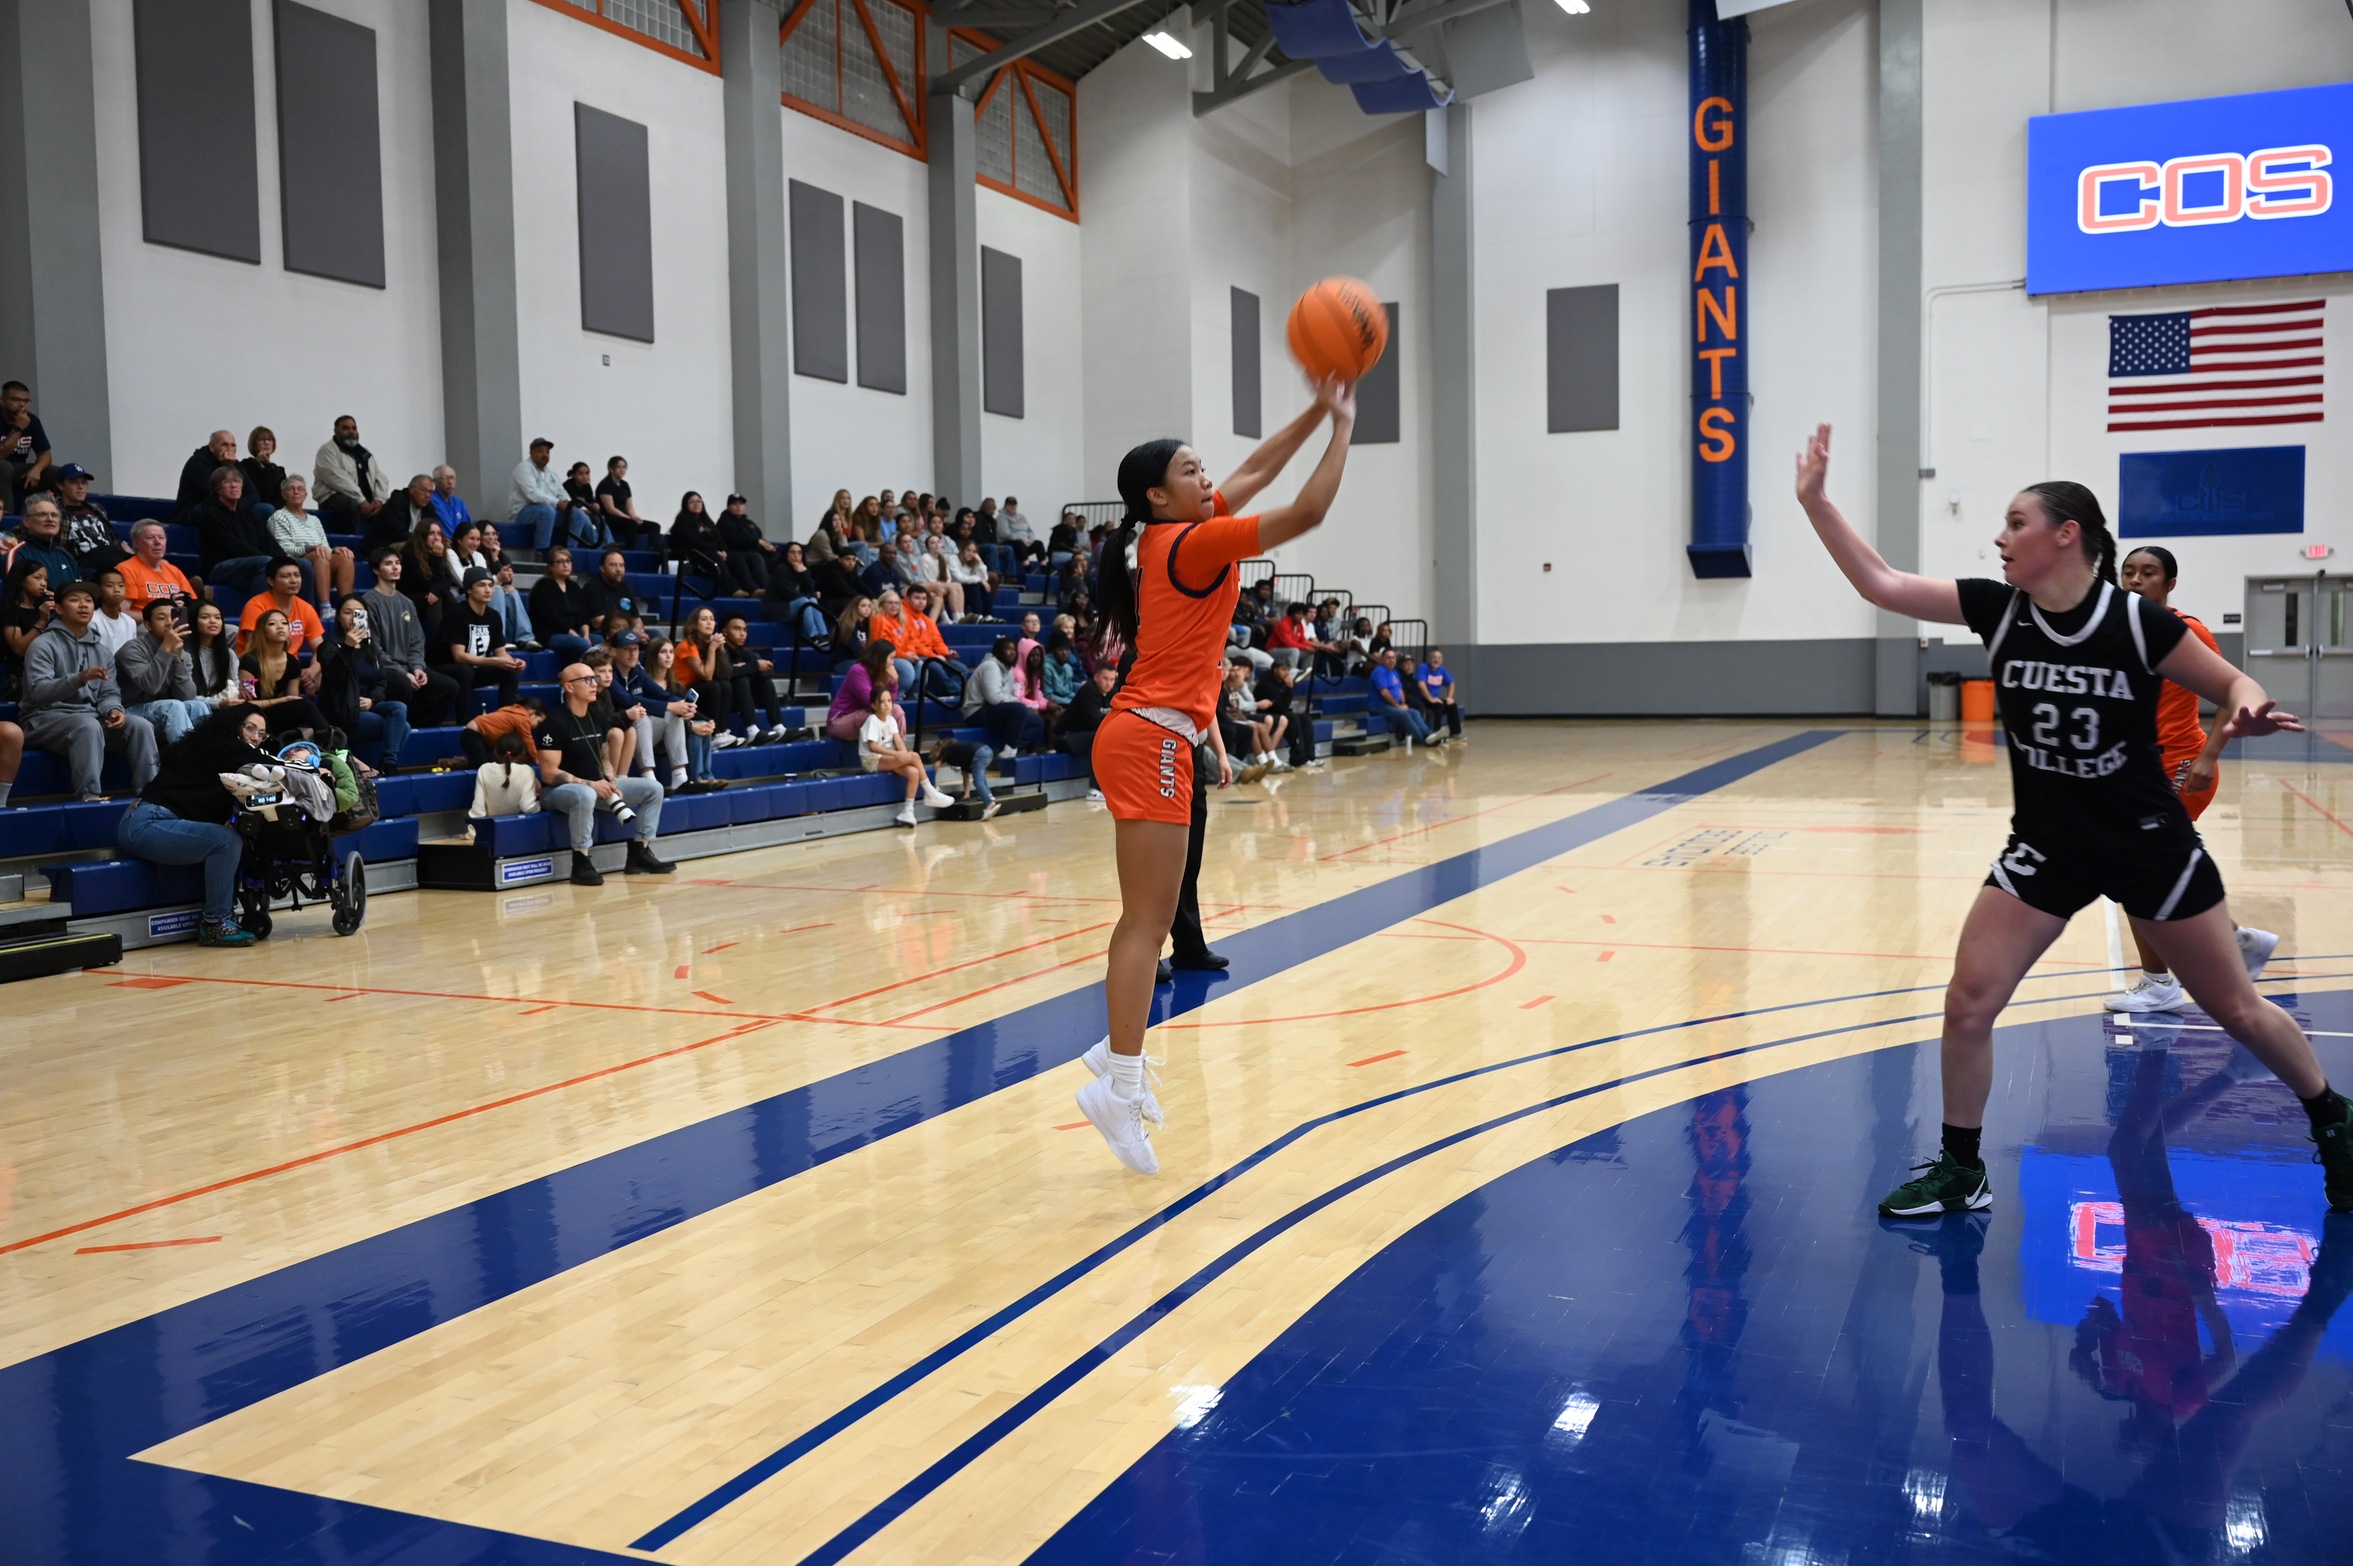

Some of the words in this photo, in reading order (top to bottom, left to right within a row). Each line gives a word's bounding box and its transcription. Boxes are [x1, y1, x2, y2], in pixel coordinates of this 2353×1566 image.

[2077, 143, 2333, 235] COS
[1693, 95, 1740, 463] GIANTS
[146, 582, 180, 595] COS
[2002, 660, 2136, 701] CUESTA
[2032, 702, 2100, 750] 23
[1160, 738, 1178, 798] GIANTS
[2002, 842, 2048, 876] C
